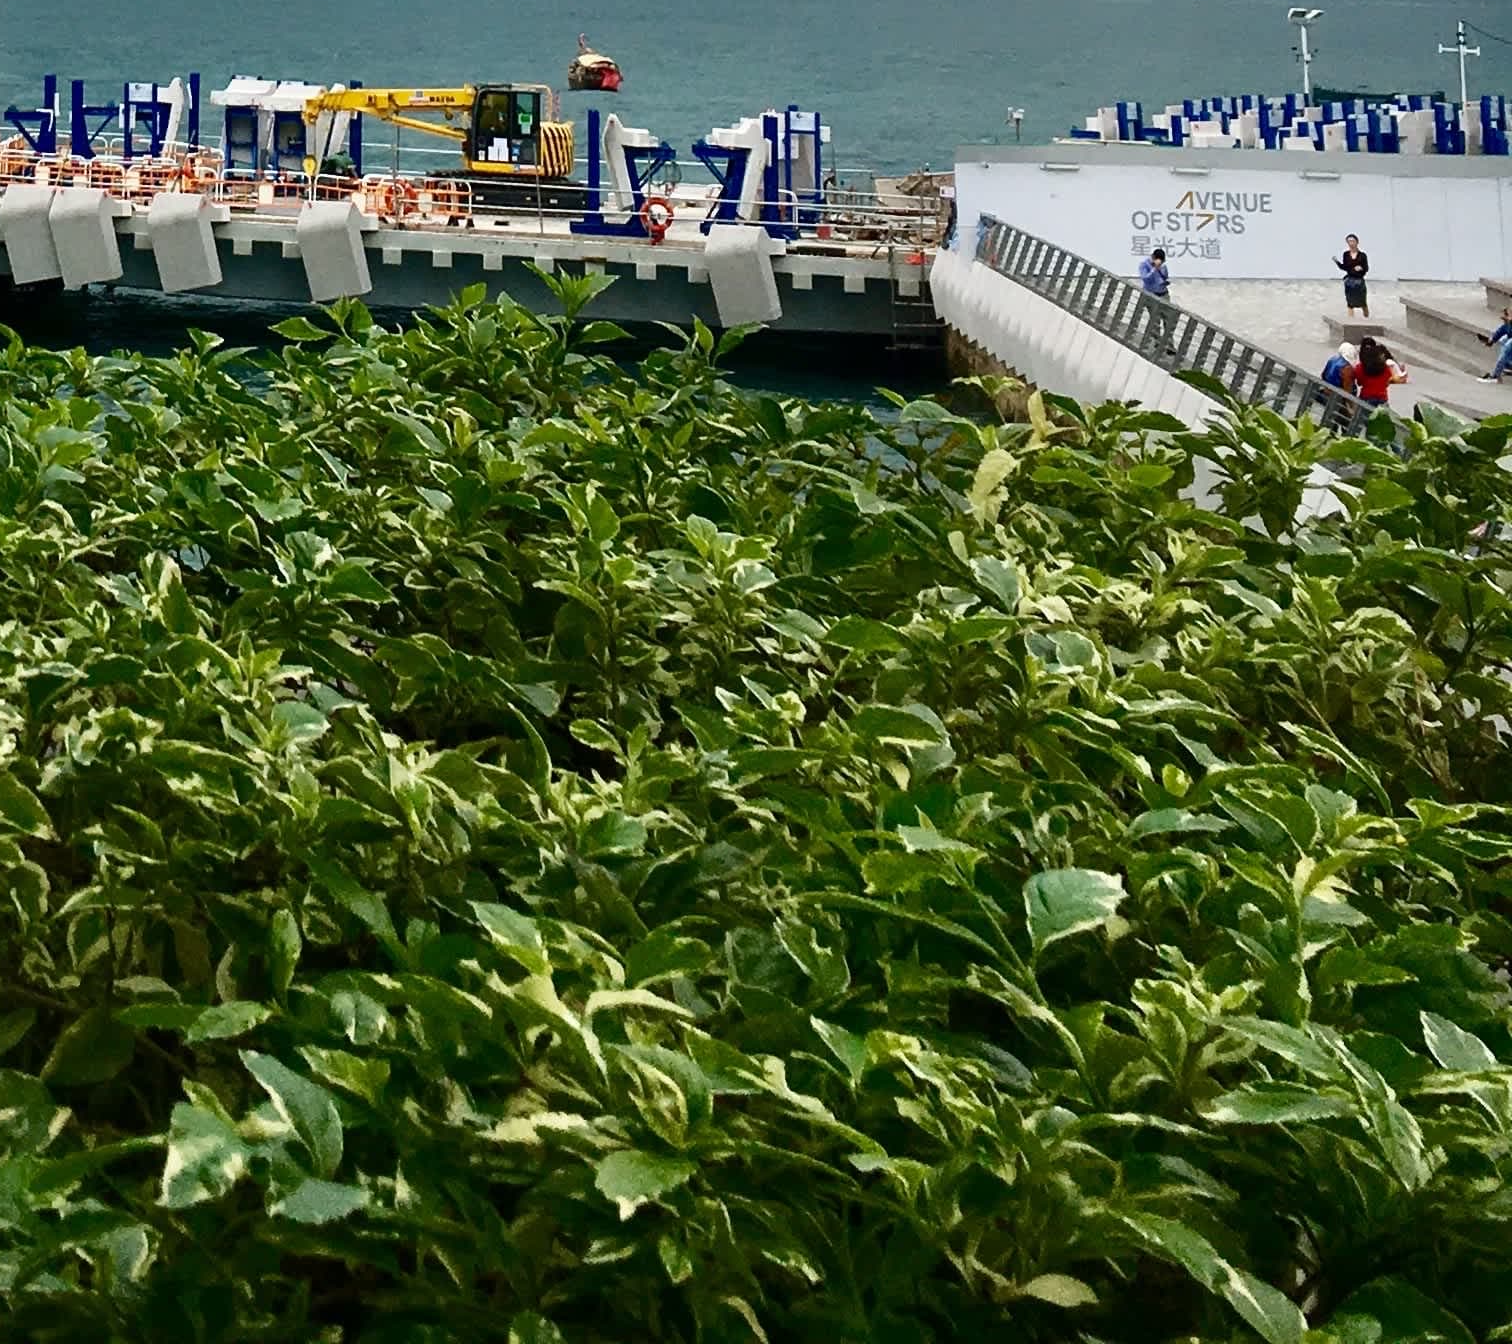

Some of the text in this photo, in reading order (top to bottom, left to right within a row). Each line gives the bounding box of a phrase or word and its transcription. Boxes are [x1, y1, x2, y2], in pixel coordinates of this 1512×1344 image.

[1175, 191, 1273, 213] AVENUE
[1131, 210, 1246, 234] OF STARS
[1131, 235, 1223, 260] 星光大道
